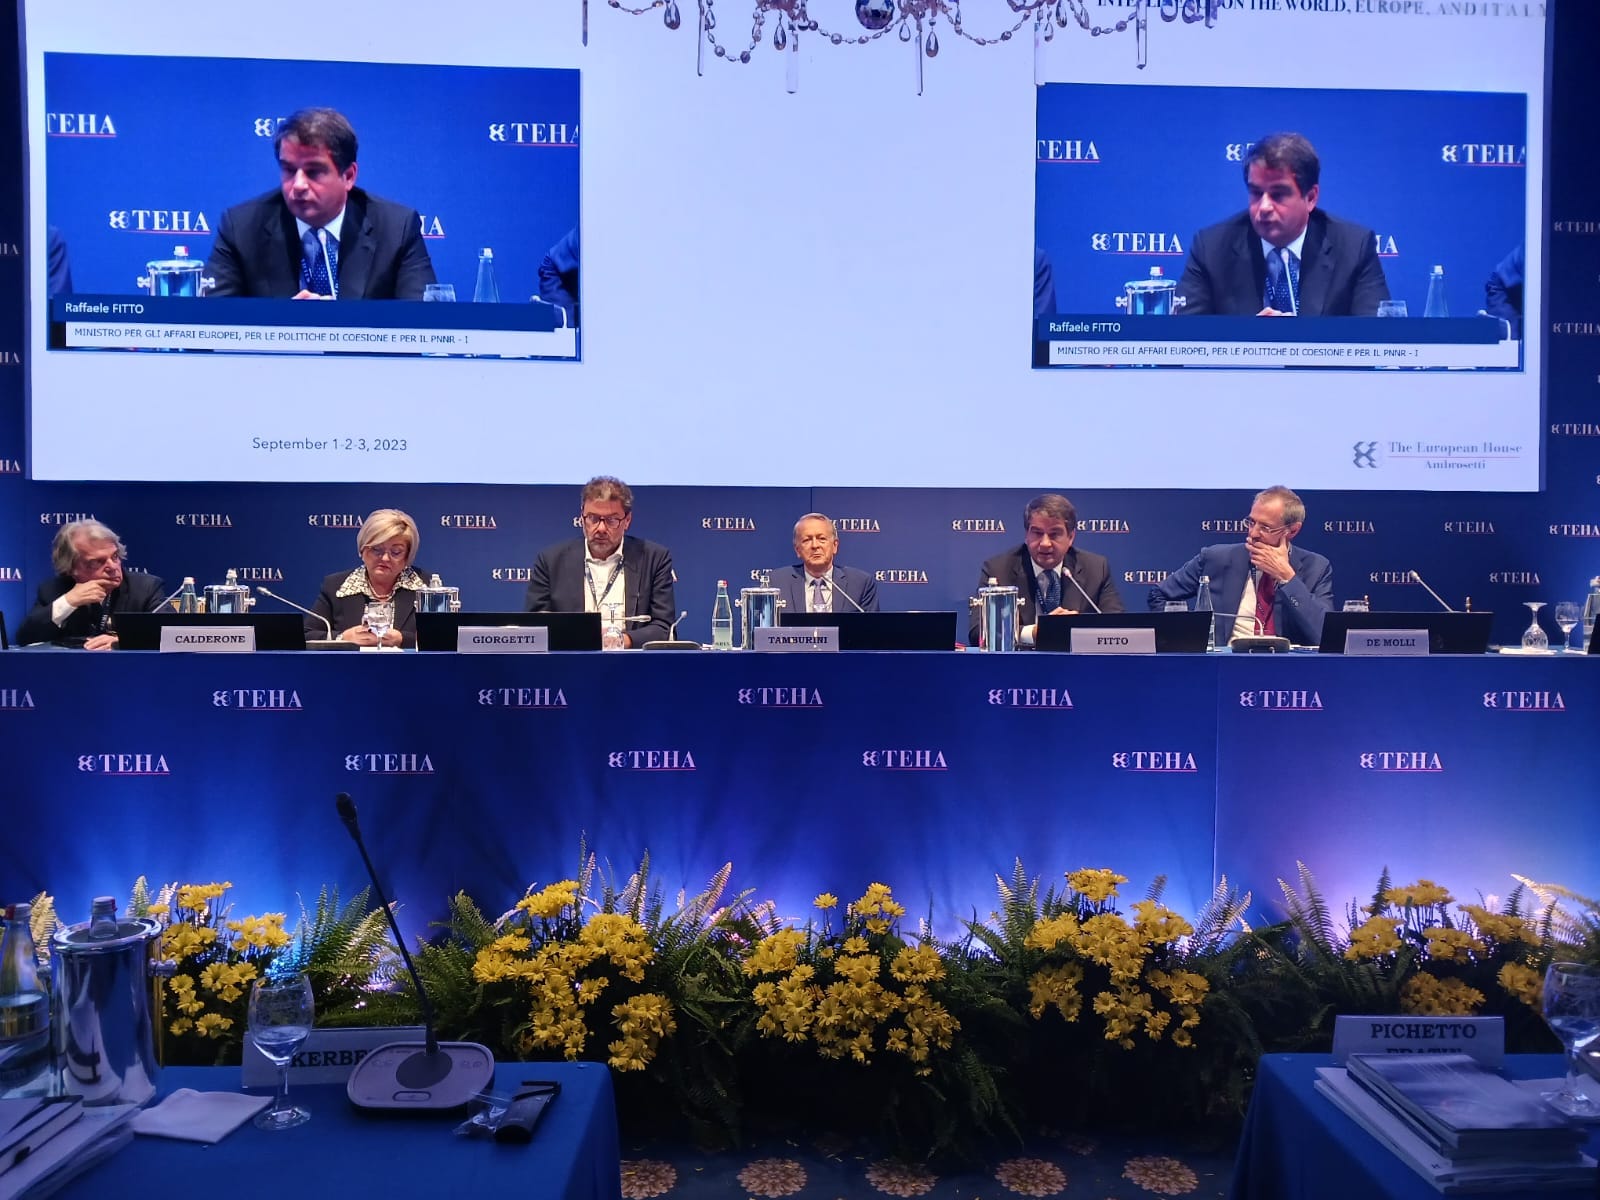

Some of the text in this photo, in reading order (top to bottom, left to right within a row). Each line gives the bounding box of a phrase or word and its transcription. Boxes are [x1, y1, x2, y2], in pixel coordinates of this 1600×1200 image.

[1250, 0, 1282, 10] THE
[1286, 0, 1351, 13] WORLD,
[131, 209, 211, 231] TEHA
[1112, 232, 1184, 252] TEHA
[65, 302, 144, 314] Raffaele FITTO
[1049, 322, 1121, 332] Raffaele FITTO
[74, 328, 122, 337] MINISTRO
[124, 328, 143, 337] PER
[145, 329, 161, 338] GLI
[163, 329, 196, 339] AFFARI
[198, 330, 242, 341] EUROPEI,
[245, 331, 262, 340] PER
[264, 331, 276, 341] LE
[278, 332, 327, 341] POLITICHE
[329, 333, 340, 342] DI
[342, 333, 389, 343] COESIONE
[391, 334, 397, 343] E
[399, 334, 417, 343] PER
[419, 334, 429, 343] IL
[430, 335, 456, 344] PNNR
[1057, 346, 1100, 355] MINISTRO
[1102, 347, 1119, 355] PER
[1121, 347, 1135, 356] GLI
[1138, 347, 1167, 356] AFFARI
[1170, 347, 1209, 357] EUROPEI,
[1211, 347, 1228, 356] PER
[1230, 347, 1240, 356] LE
[1242, 347, 1287, 356] POLITICHE
[1289, 348, 1299, 356] DI
[1301, 348, 1345, 357] COESIONE
[1347, 348, 1352, 357] E
[1354, 348, 1370, 357] PER
[1373, 348, 1381, 357] IL
[1383, 349, 1406, 357] PNNR
[252, 437, 328, 452] September
[373, 439, 408, 451] 2023
[1389, 441, 1523, 456] The European House
[1425, 460, 1486, 469] Ambrosetti
[188, 514, 232, 526] TEHA
[453, 515, 497, 527] TEHA
[714, 518, 755, 529] TEHA
[838, 519, 880, 530] TEHA
[964, 520, 1005, 531] TEHA
[1088, 520, 1130, 531] TEHA
[1336, 521, 1375, 532] TEHA
[1561, 524, 1600, 536] TEHA
[240, 568, 283, 579] TEHA
[887, 570, 929, 582] TEHA
[1500, 572, 1541, 583] TEHA
[175, 636, 246, 644] CALDERONE
[472, 635, 536, 644] GIORGETTI
[768, 636, 828, 644] TAMBURINI
[1097, 637, 1129, 645] FITTO
[1366, 638, 1416, 647] DE MOLLI
[233, 689, 302, 708] TEHA
[499, 688, 568, 706] TEHA
[757, 687, 824, 705] TEHA
[1008, 688, 1074, 706] TEHA
[1258, 690, 1324, 708] TEHA
[1502, 691, 1565, 709] TEHA
[98, 754, 170, 773] TEHA
[365, 753, 434, 772] TEHA
[628, 750, 696, 769] TEHA
[881, 750, 947, 769] TEHA
[1132, 752, 1197, 770] TEHA
[1378, 752, 1443, 770] TEHA
[1370, 1023, 1477, 1039] PICHETTO
